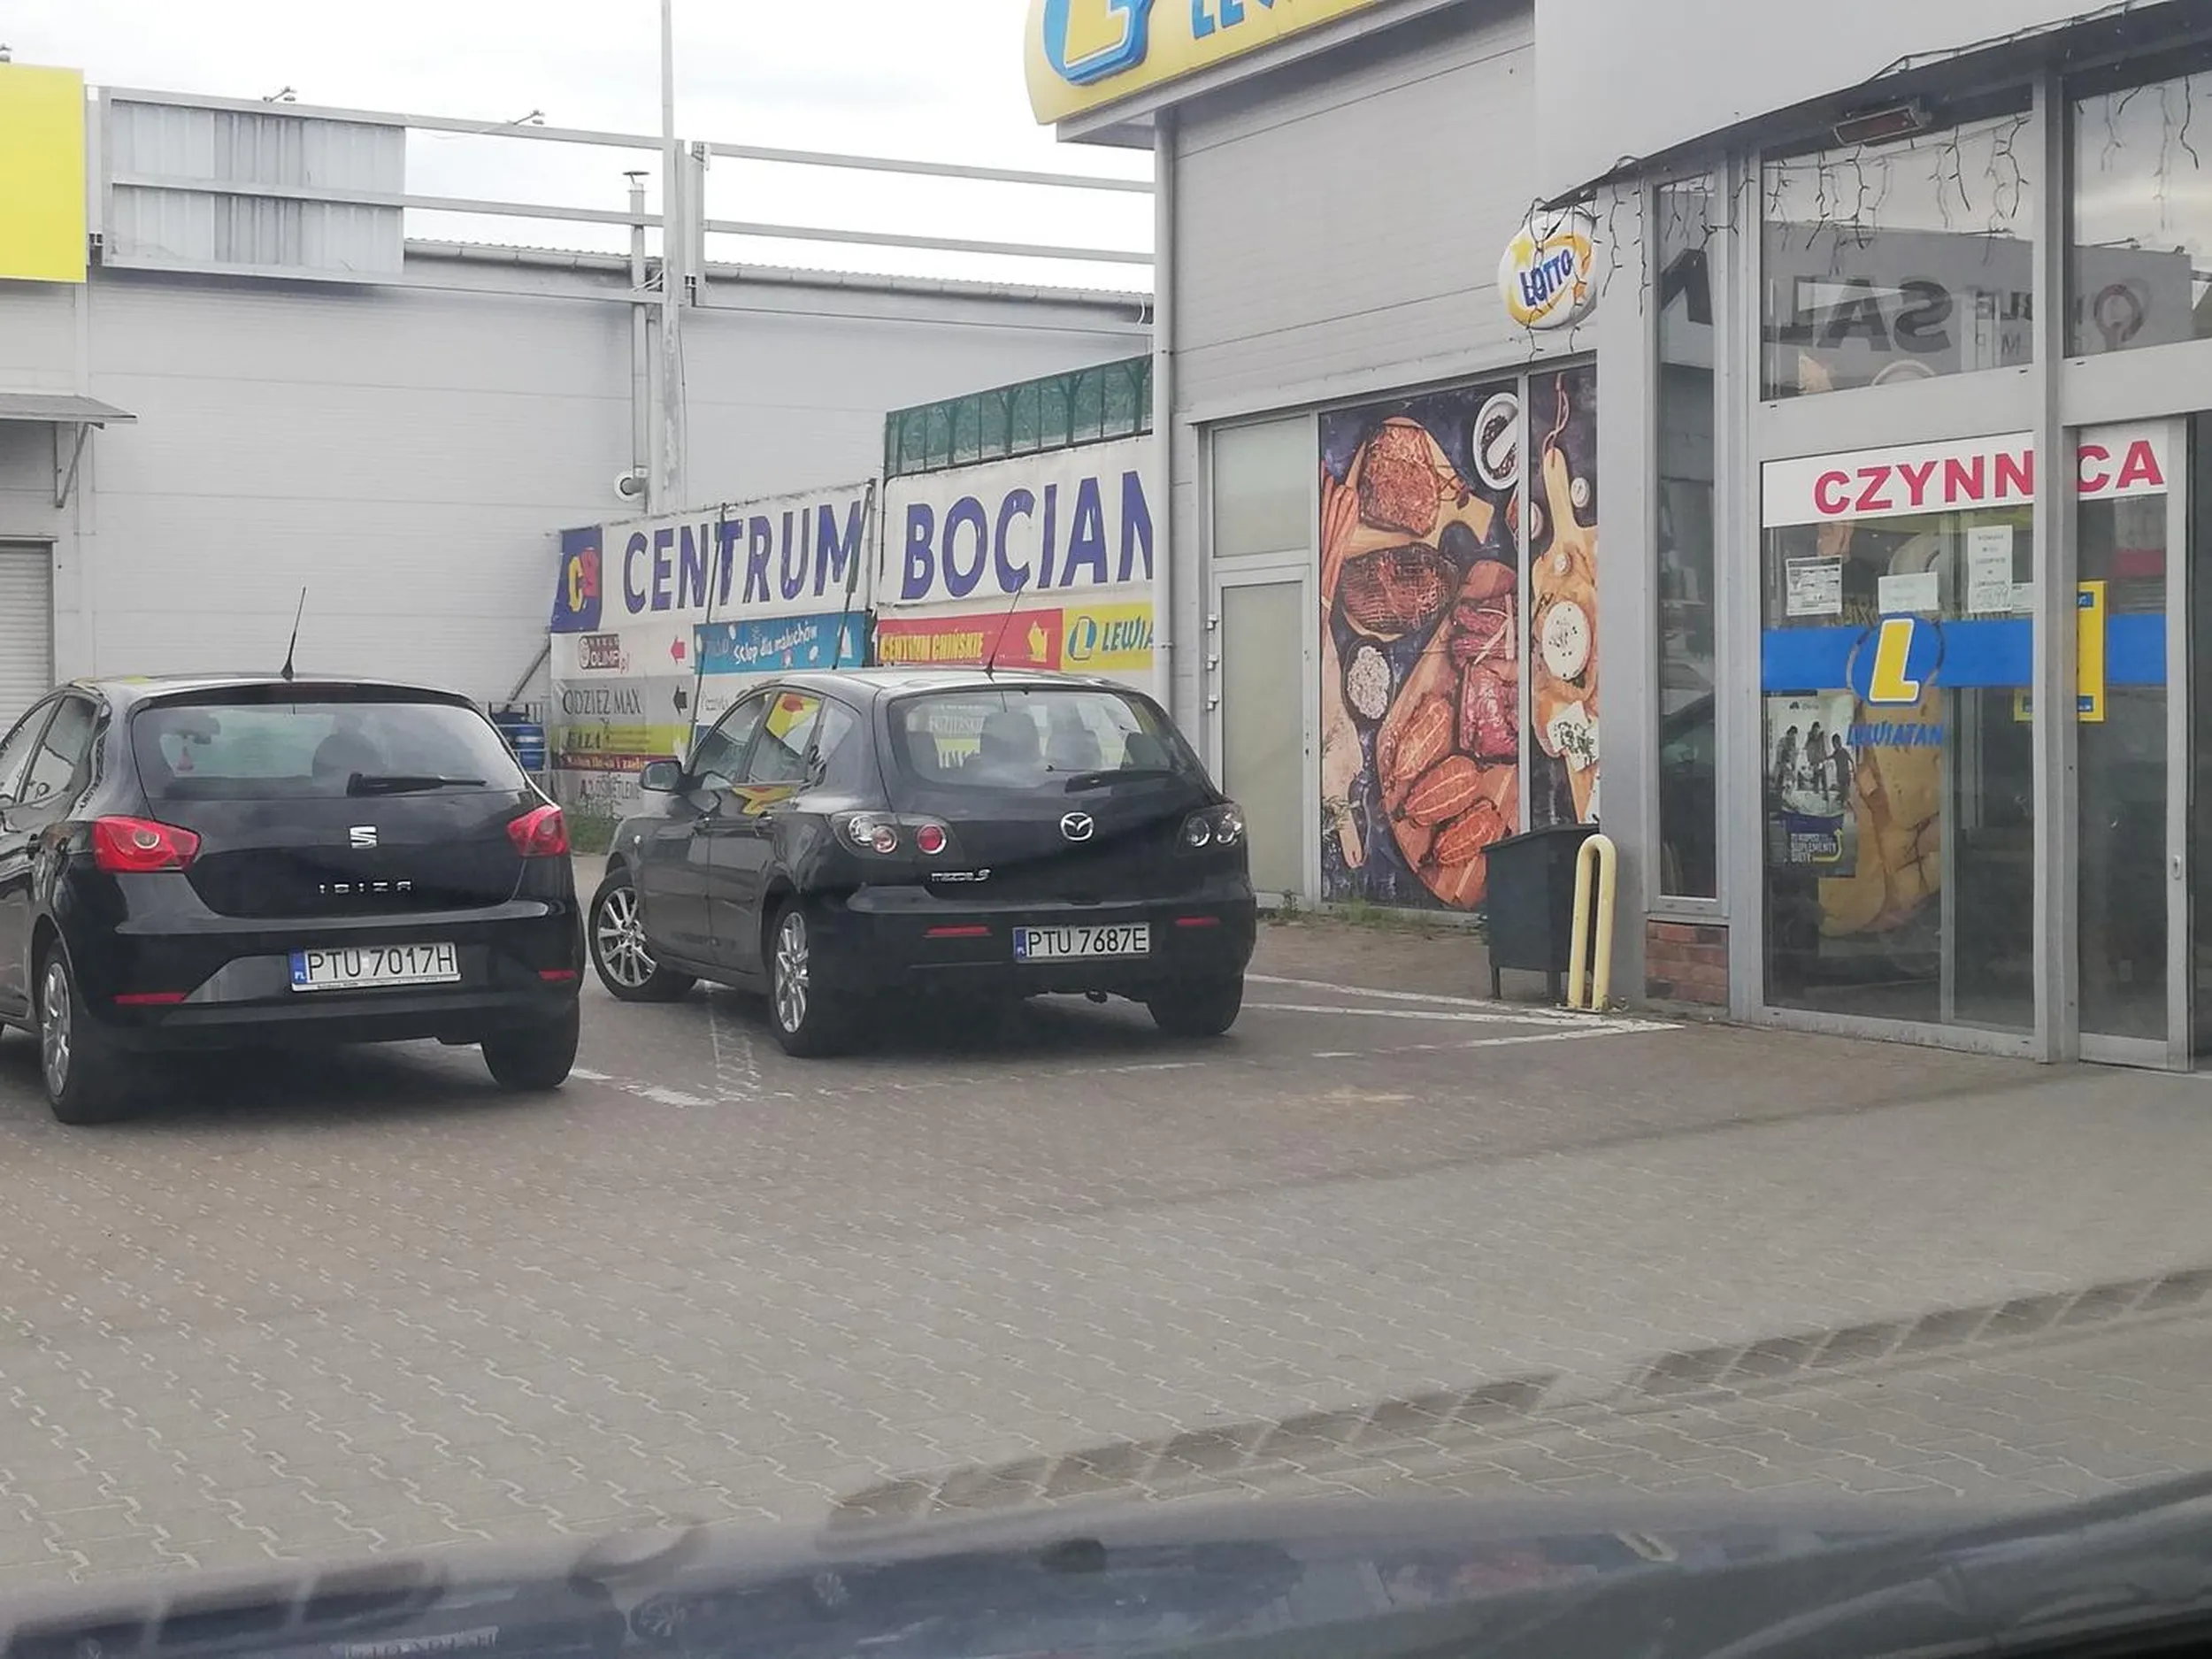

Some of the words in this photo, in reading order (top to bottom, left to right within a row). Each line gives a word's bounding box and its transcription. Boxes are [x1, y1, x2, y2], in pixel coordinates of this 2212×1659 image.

[1519, 249, 1572, 307] LOTTO
[624, 501, 862, 614] CENTRUM
[901, 471, 1154, 600] BOCIAN
[307, 949, 361, 981] PTU
[369, 945, 455, 978] 7017H
[1028, 930, 1071, 956] PTU
[1078, 927, 1147, 954] 7687E
